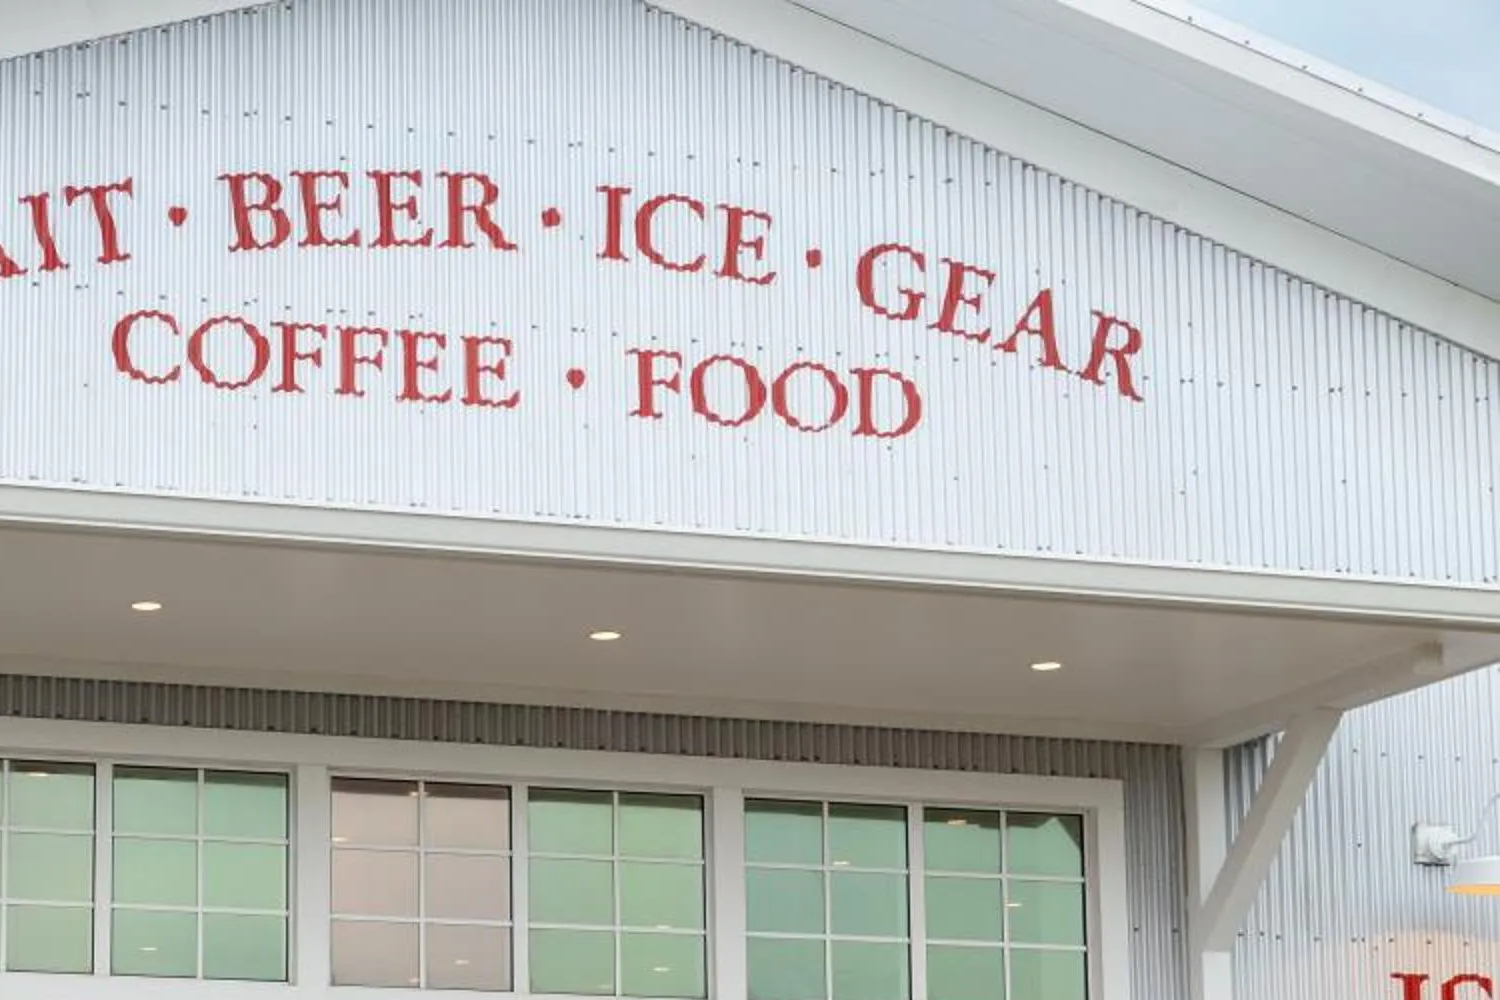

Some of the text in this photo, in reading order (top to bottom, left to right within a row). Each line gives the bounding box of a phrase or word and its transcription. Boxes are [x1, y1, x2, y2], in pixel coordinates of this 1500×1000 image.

[112, 310, 922, 438] COFFEE FOOD
[218, 171, 519, 252] BEER
[597, 185, 776, 285] ICE
[855, 243, 1144, 401] GEAR
